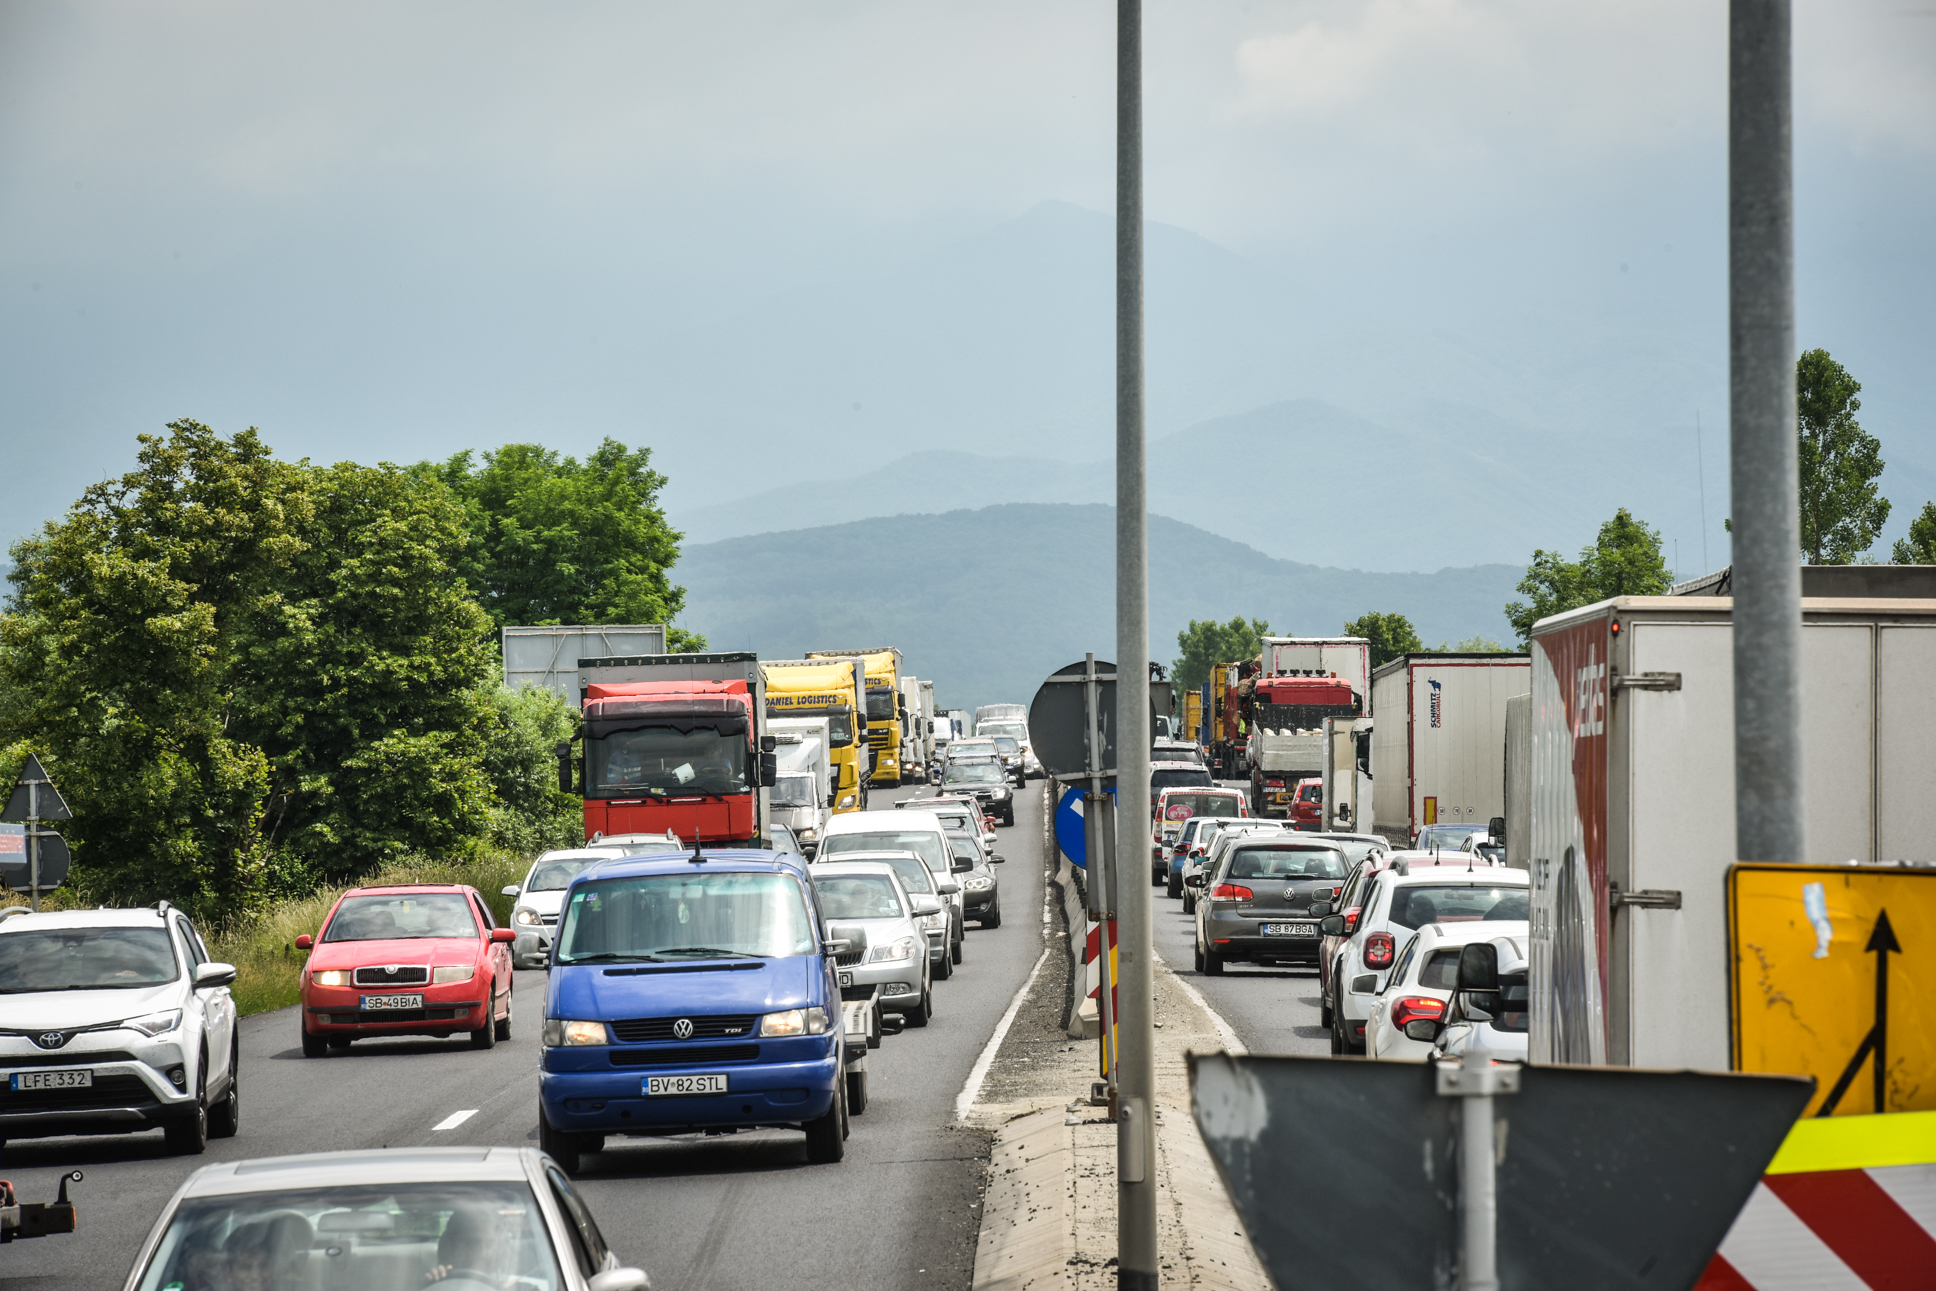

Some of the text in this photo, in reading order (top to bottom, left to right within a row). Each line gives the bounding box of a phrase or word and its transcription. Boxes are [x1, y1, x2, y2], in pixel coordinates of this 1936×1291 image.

[765, 695, 837, 706] DANIEL LOGISTICS
[1269, 924, 1281, 932] SB
[368, 998, 383, 1008] SB
[24, 1072, 86, 1088] LFE 332
[650, 1077, 724, 1092] BV 82 STL
